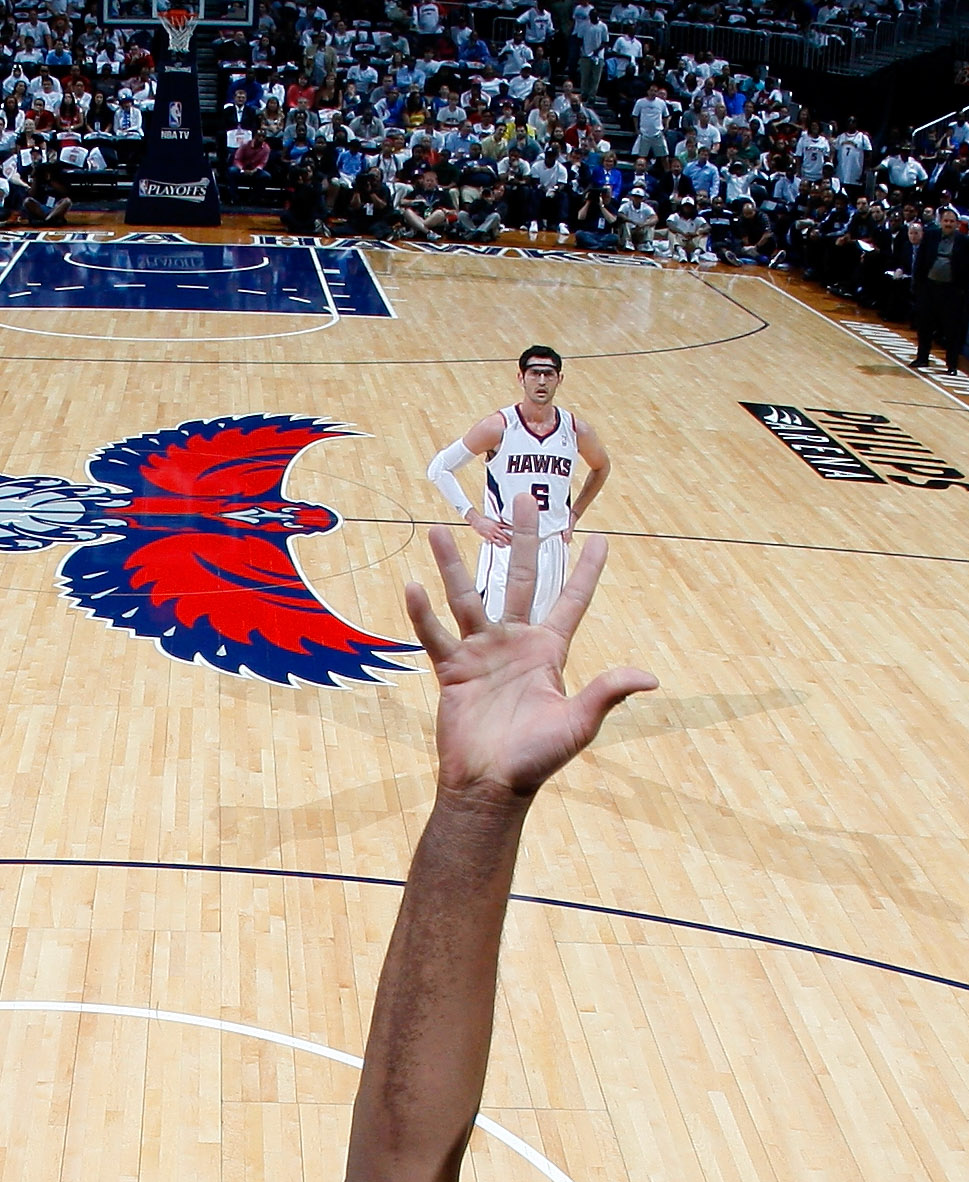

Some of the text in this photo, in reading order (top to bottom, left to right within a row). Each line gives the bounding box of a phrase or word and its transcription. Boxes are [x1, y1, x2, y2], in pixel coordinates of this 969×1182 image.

[160, 130, 190, 140] NBA TV
[147, 184, 208, 197] PLAYOFFS
[764, 421, 875, 479] ARENA
[506, 453, 572, 478] HAWKS
[530, 483, 550, 512] 5
